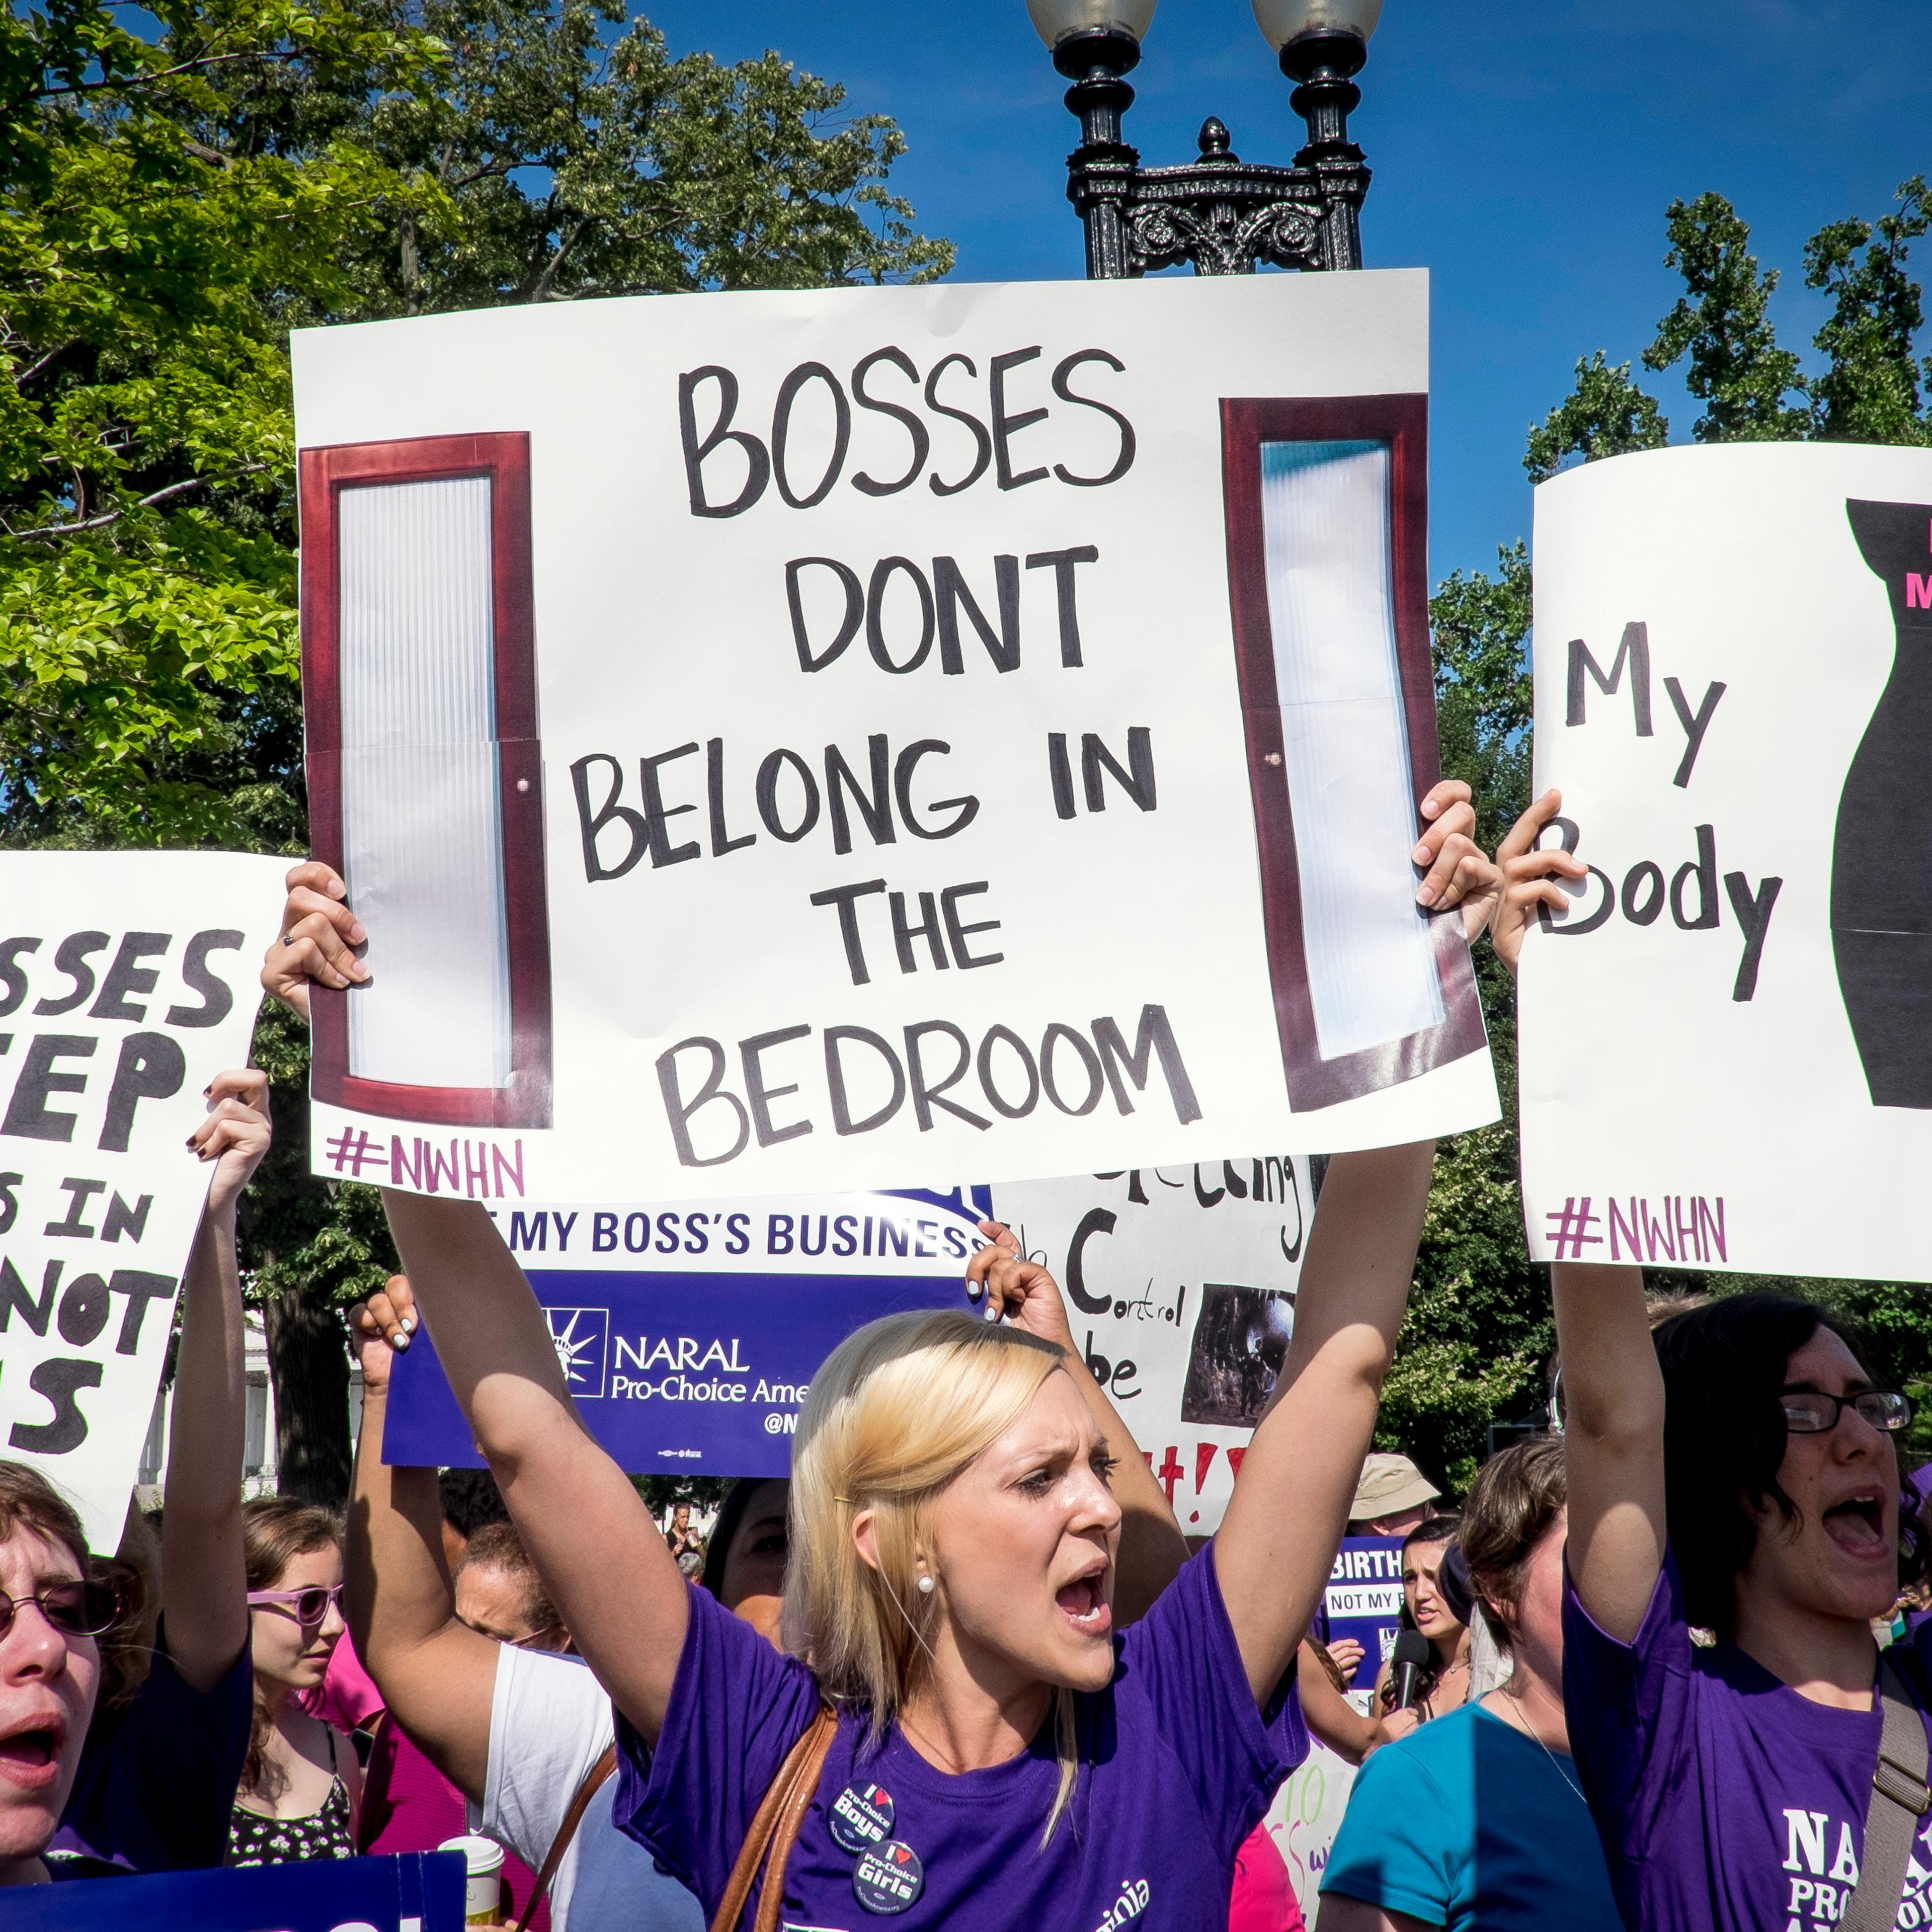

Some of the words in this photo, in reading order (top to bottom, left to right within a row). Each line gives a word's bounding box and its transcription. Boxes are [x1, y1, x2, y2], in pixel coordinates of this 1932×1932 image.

[678, 345, 1136, 518] BOSSES
[784, 544, 1099, 676] DONT
[1566, 621, 1727, 789] My
[569, 733, 979, 884] BELONG
[1049, 726, 1157, 820] IN
[809, 877, 1005, 986] THE
[1533, 817, 1784, 1003] Body
[0, 1031, 186, 1153] EP
[656, 1004, 1202, 1169] BEDROOM
[326, 1126, 525, 1198] #NWHN
[43, 1177, 154, 1244] IN
[510, 1212, 579, 1252] MY
[591, 1212, 751, 1255] BOSS'S
[1546, 1195, 1728, 1263] #NWHN
[1066, 1207, 1186, 1327] Control
[0, 1255, 179, 1356] NOT
[614, 1335, 751, 1373] NARAL
[1085, 1330, 1142, 1400] be
[0, 1357, 104, 1455] S
[610, 1374, 747, 1402] Pro-Choice
[751, 1378, 810, 1404] Ame
[764, 1412, 799, 1434] @N
[1329, 1550, 1403, 1579] BIRTH
[1331, 1593, 1363, 1611] NOT
[1367, 1592, 1392, 1608] MY
[833, 1794, 884, 1842] Boys
[843, 1787, 891, 1829] Pro-Choice
[863, 1783, 877, 1800] I
[857, 1862, 913, 1900] Girls
[864, 1852, 918, 1884] Pro-Choice
[885, 1844, 897, 1861] I
